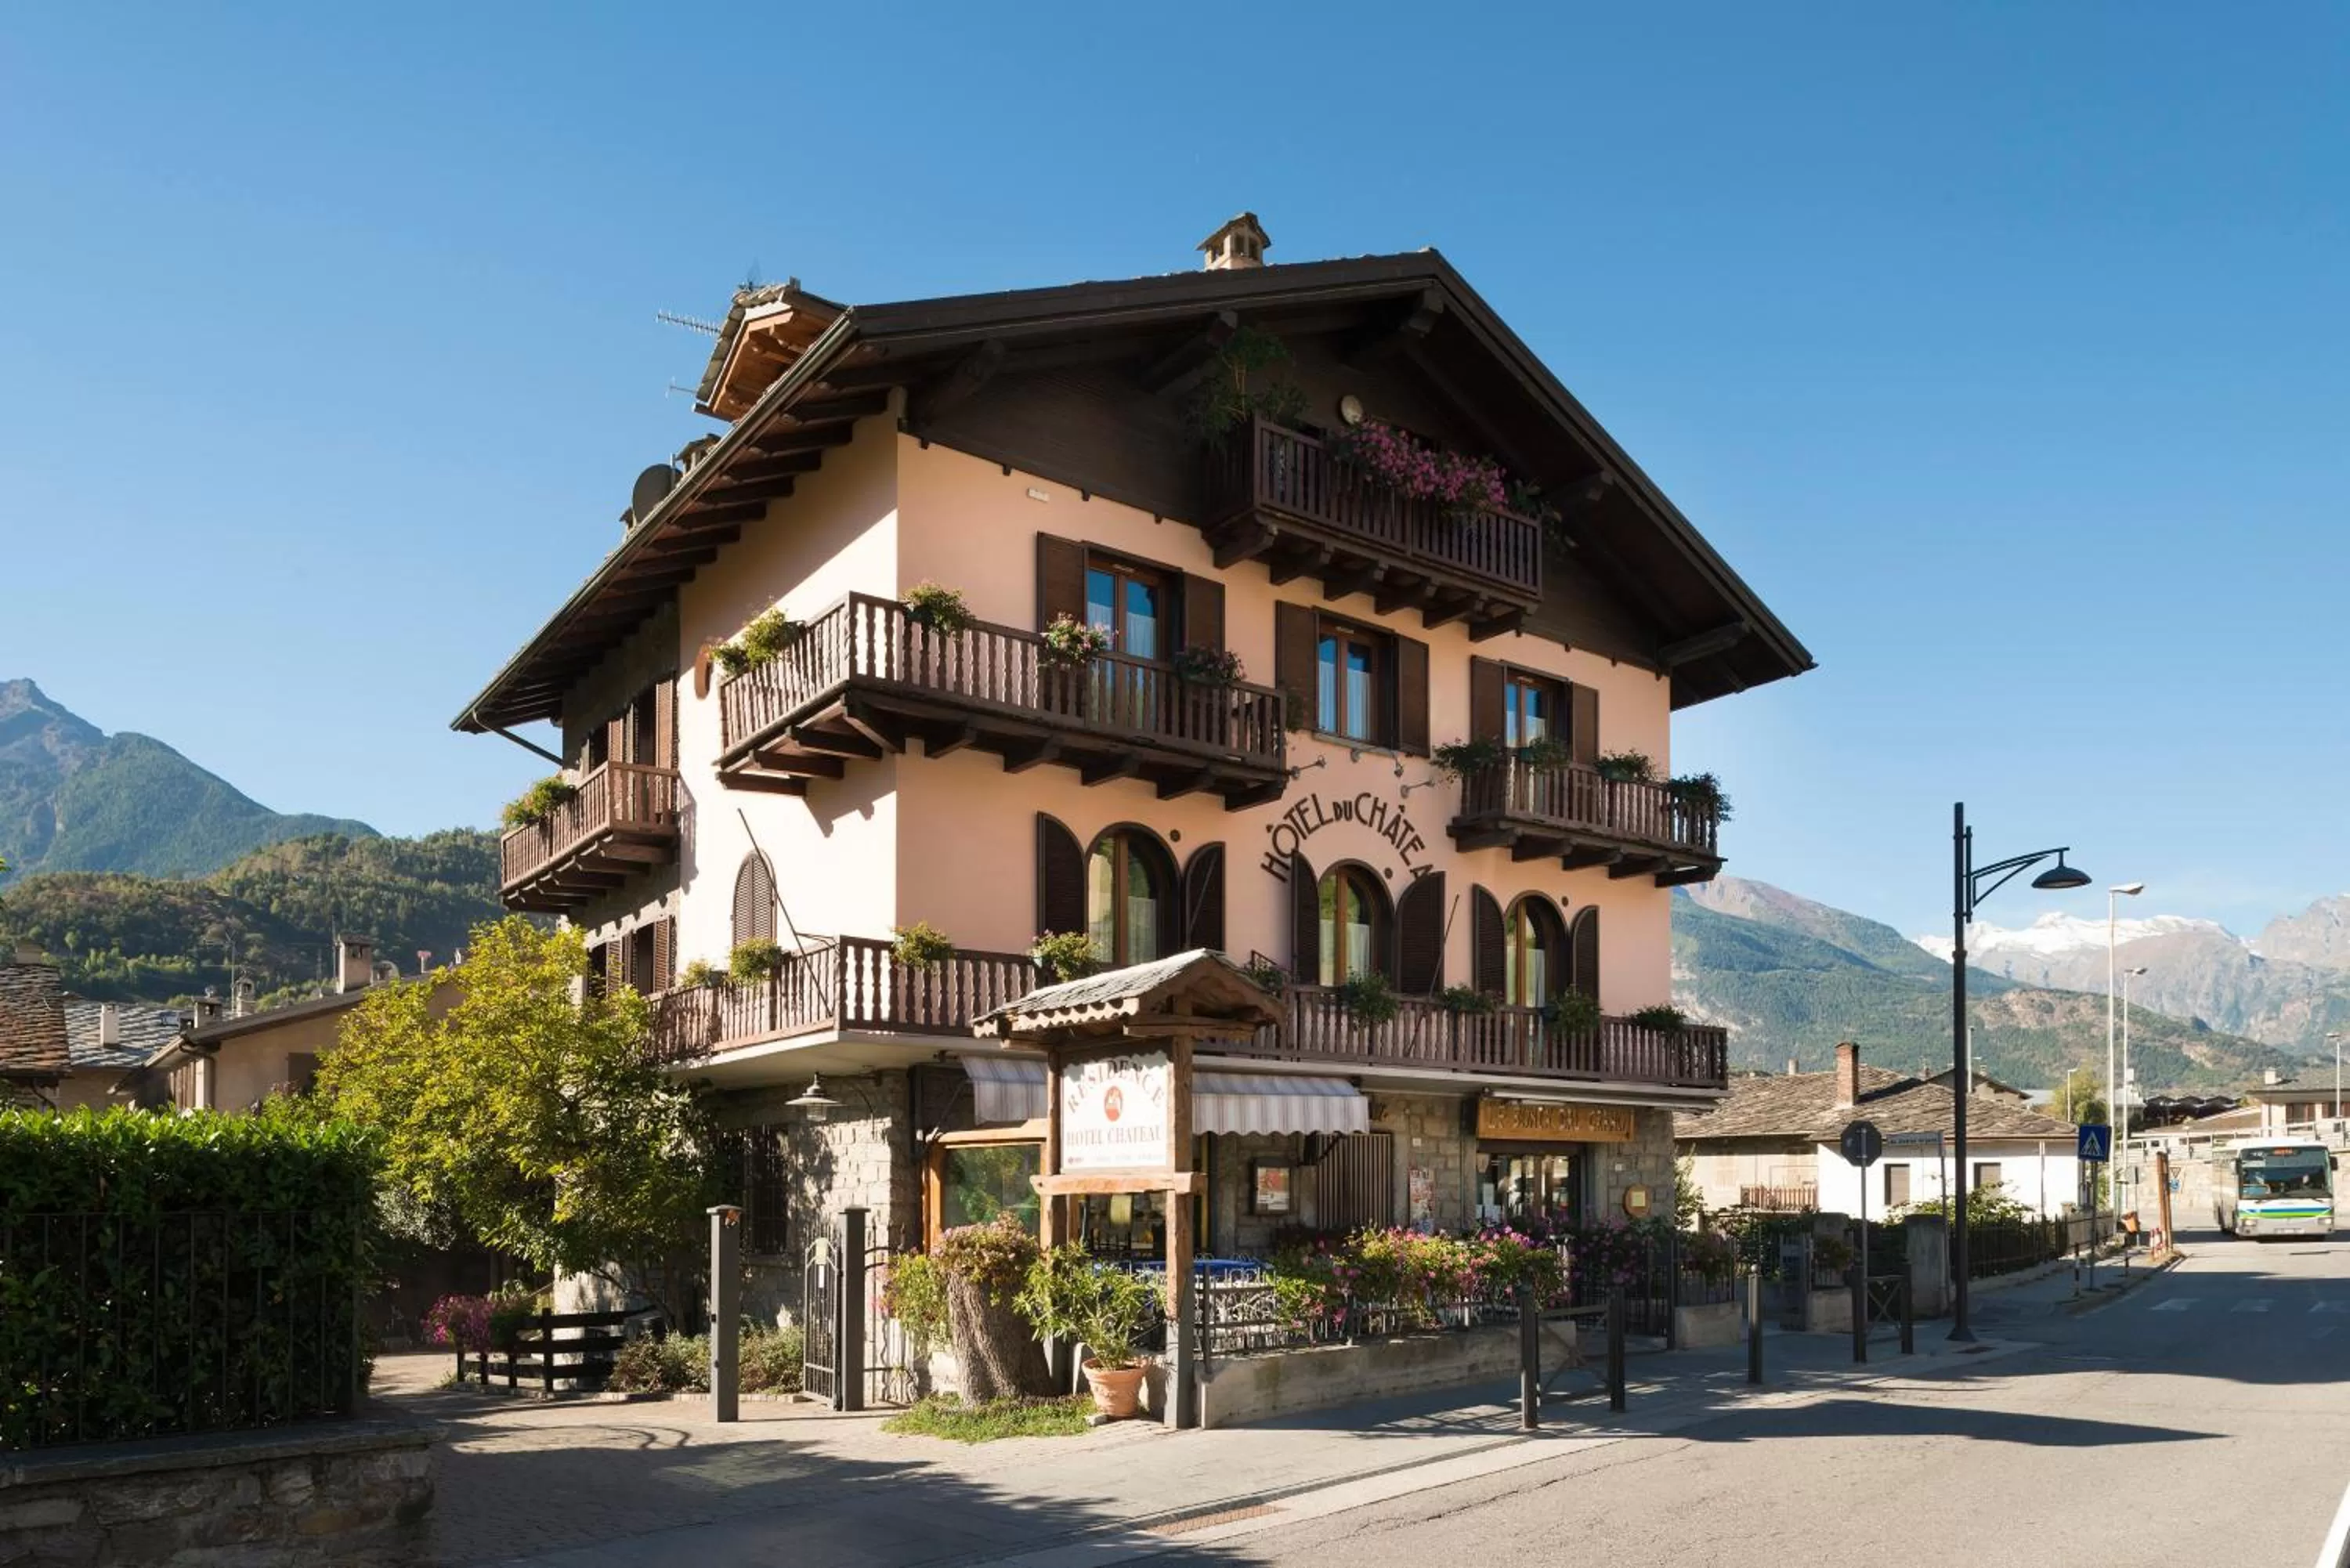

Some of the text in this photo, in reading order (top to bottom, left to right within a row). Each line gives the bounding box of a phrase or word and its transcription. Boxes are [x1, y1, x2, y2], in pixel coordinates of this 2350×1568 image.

[1333, 800, 1353, 821] DU
[1354, 792, 1434, 878] CHÂTEA
[1067, 1128, 1103, 1147] HOTEL
